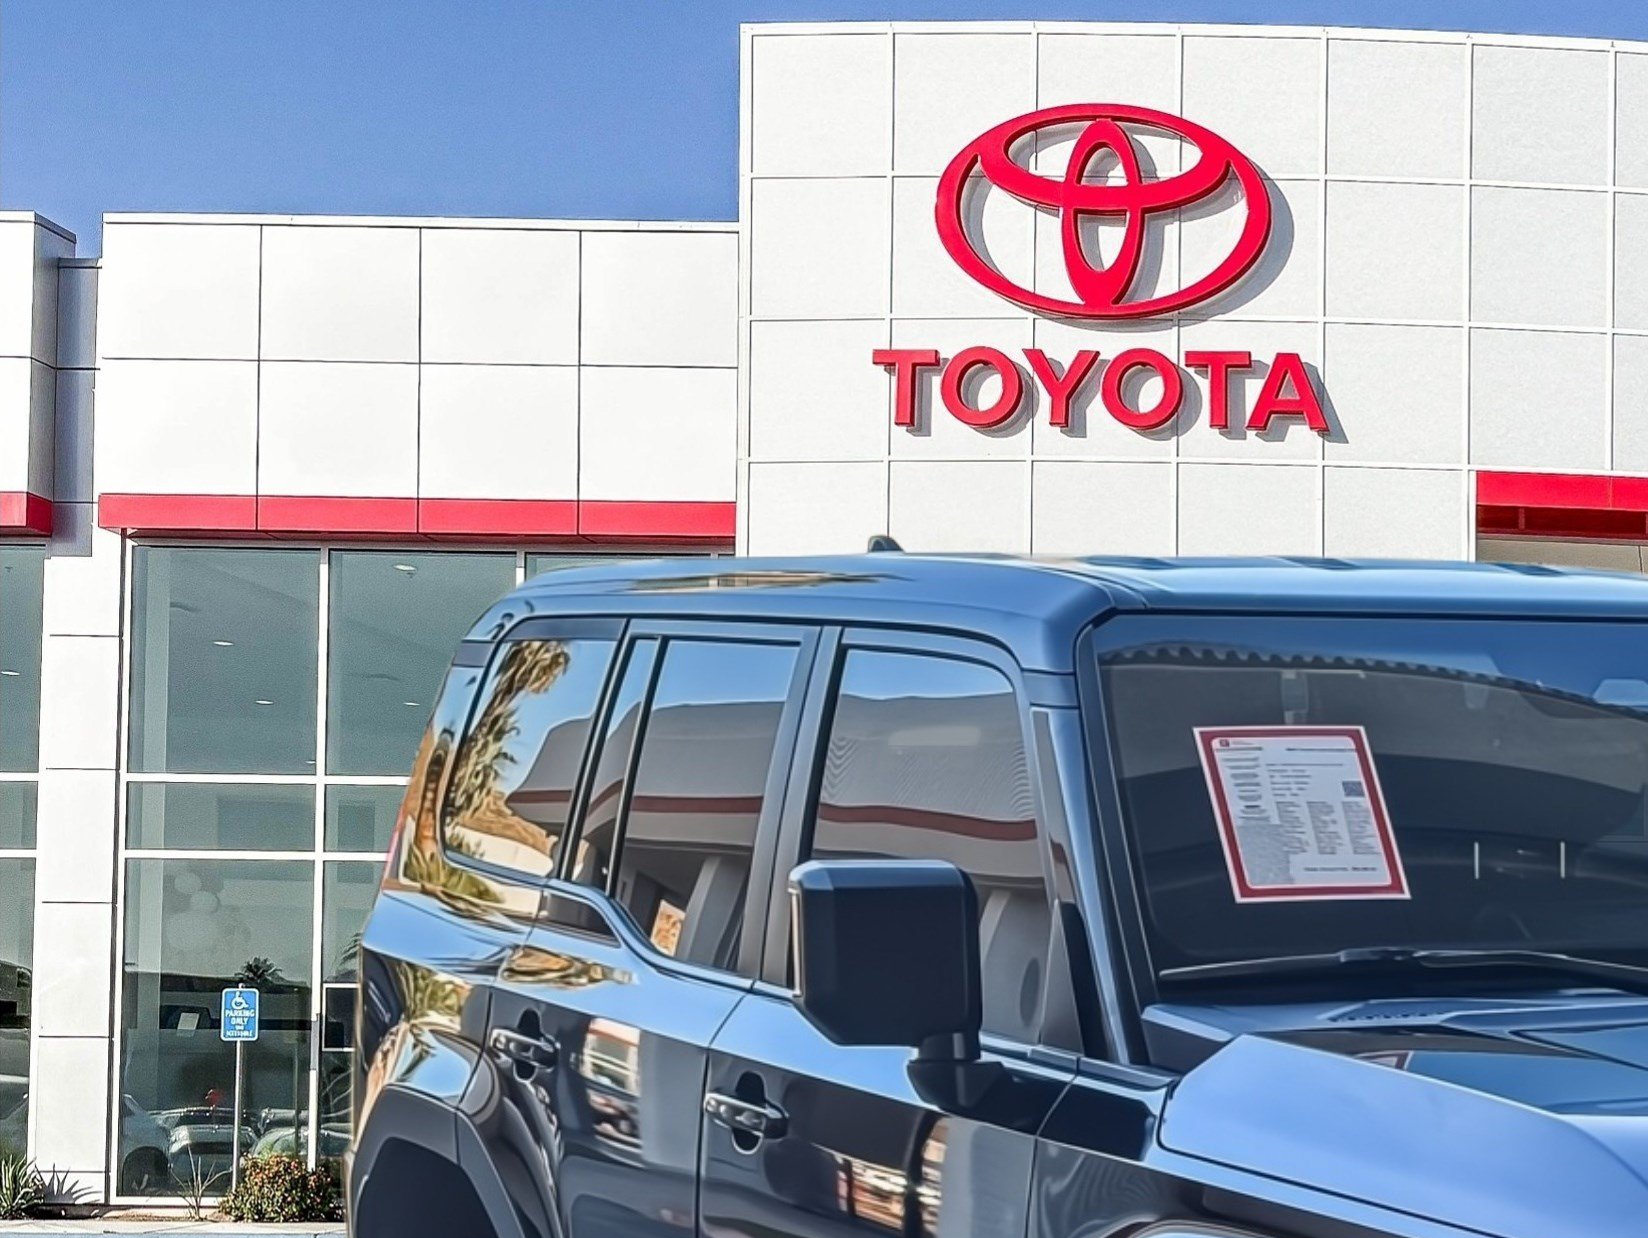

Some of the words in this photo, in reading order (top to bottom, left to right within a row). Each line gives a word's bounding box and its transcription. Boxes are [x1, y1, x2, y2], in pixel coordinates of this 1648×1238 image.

[872, 346, 1330, 433] TOYOTA
[225, 1009, 255, 1017] PARKING
[230, 1017, 249, 1025] ONLY
